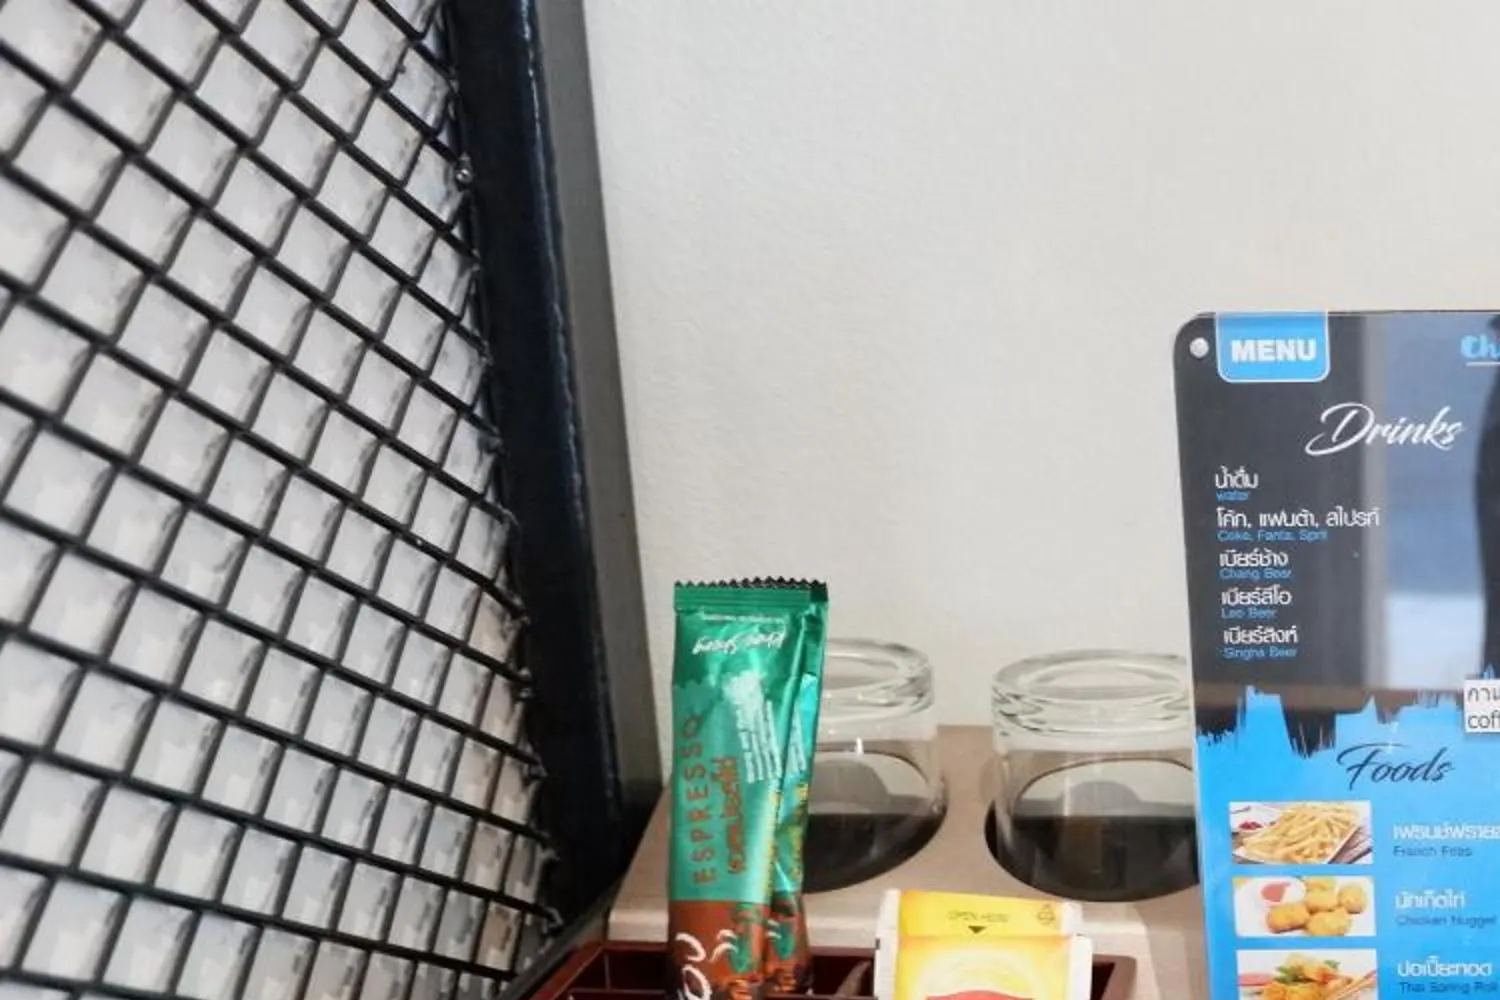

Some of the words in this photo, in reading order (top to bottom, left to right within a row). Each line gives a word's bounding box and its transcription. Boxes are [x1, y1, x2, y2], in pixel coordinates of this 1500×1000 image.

[1231, 339, 1317, 362] MENU
[1304, 402, 1465, 456] Drinks
[1336, 742, 1455, 790] Foods
[679, 714, 718, 886] ESPRESSO
